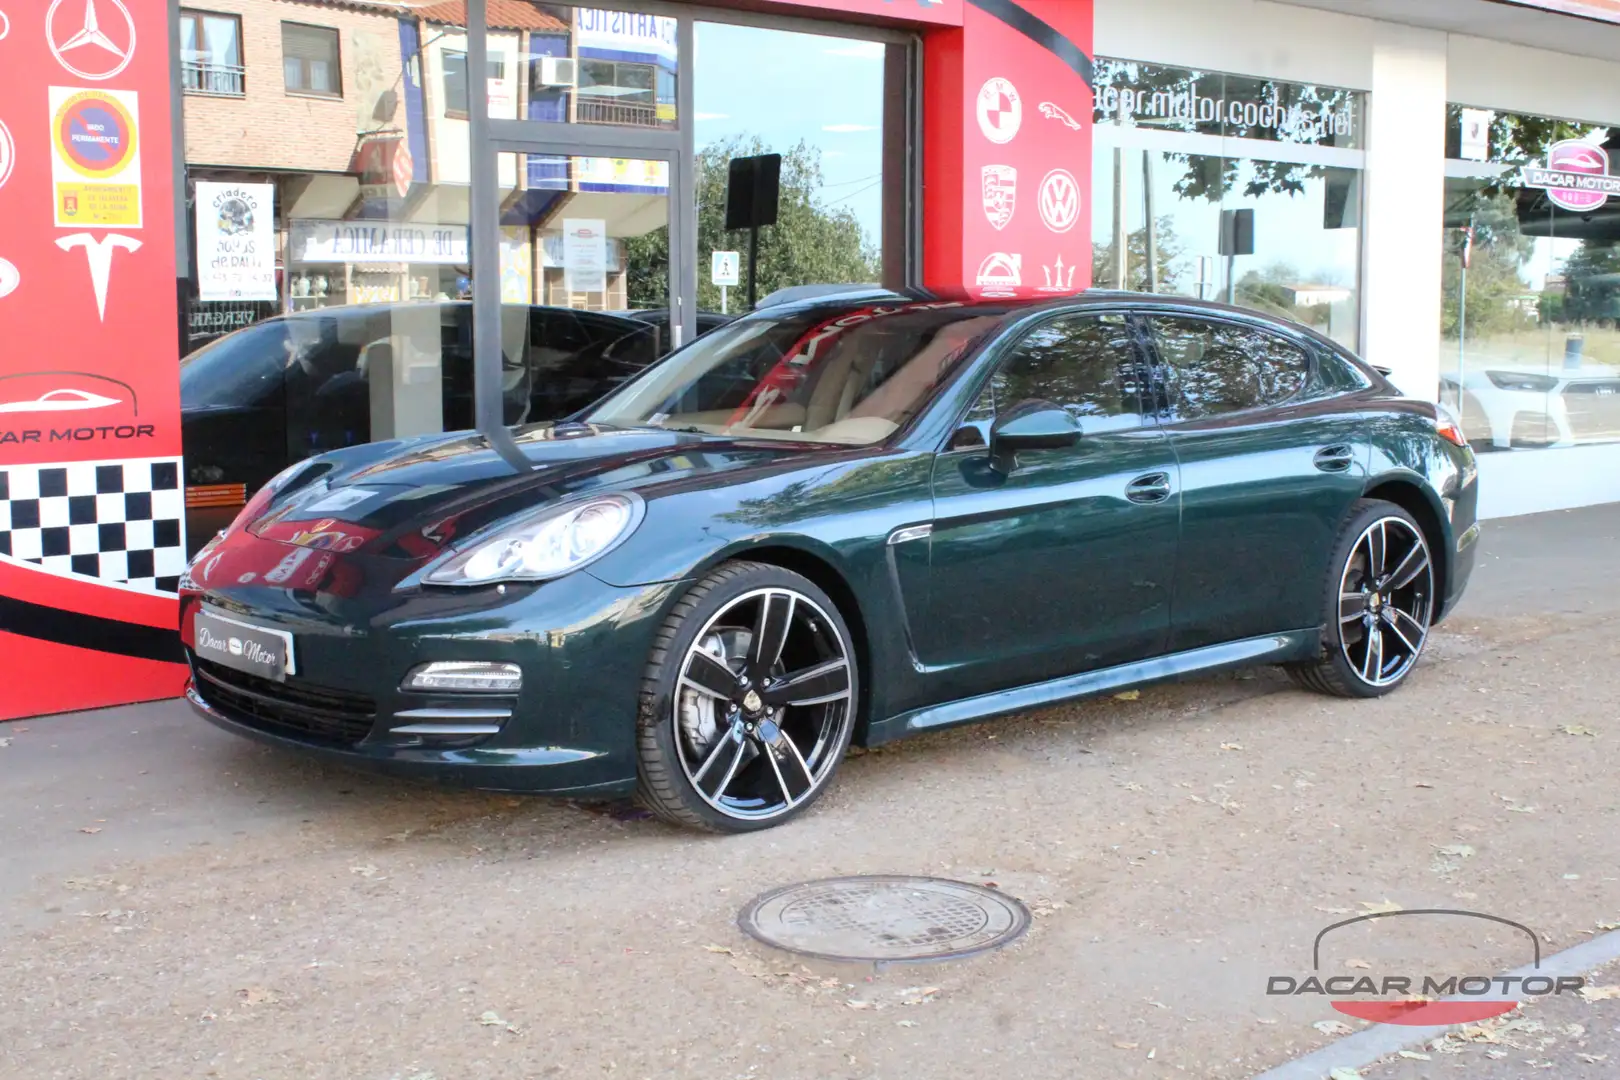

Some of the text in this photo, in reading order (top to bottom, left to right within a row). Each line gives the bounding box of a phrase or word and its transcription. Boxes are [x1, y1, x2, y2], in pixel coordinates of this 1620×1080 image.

[71, 133, 120, 144] PERMANENTE
[1532, 171, 1575, 187] DACAR
[212, 187, 258, 211] criadero
[0, 424, 155, 444] AR MOTOR
[199, 627, 277, 667] Dacar Motor
